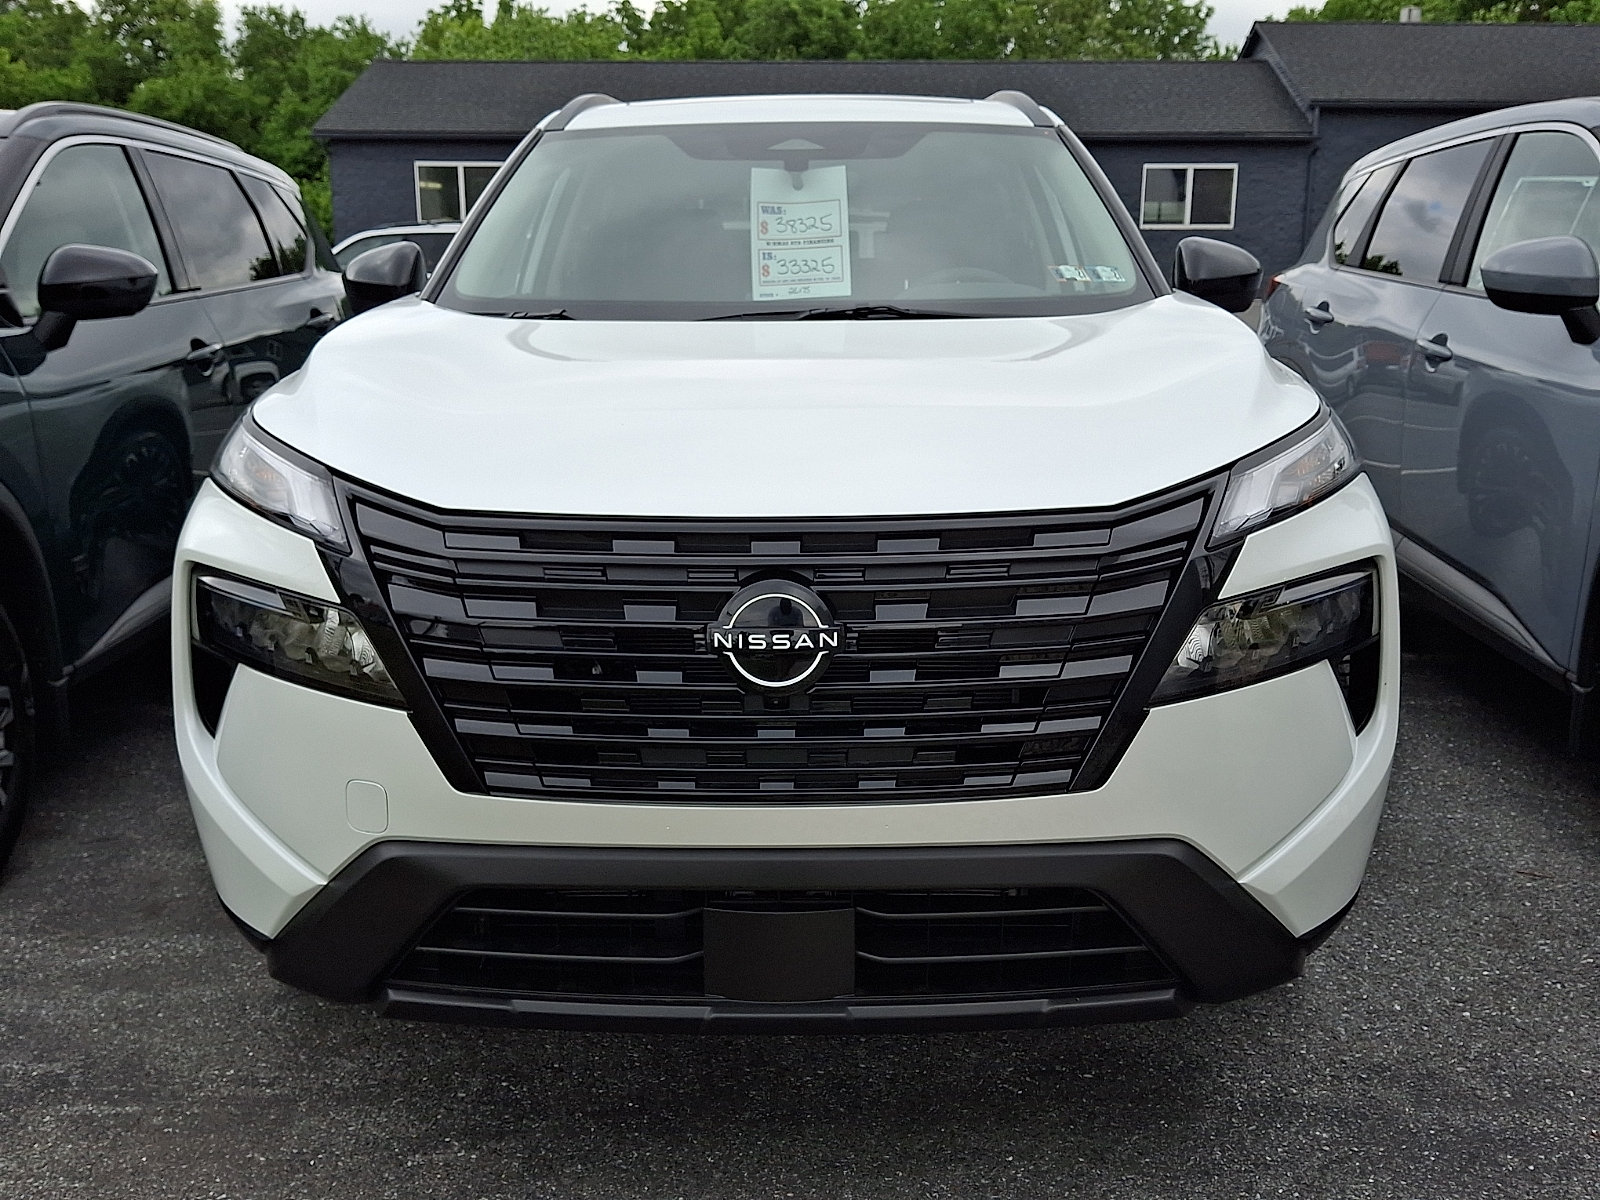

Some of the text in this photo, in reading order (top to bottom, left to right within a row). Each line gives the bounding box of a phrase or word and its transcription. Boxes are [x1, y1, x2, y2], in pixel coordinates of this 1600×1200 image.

[760, 205, 786, 215] WAS:
[775, 213, 833, 233] 38325
[762, 252, 777, 261] IS:
[776, 257, 835, 275] 33325
[713, 631, 838, 650] NISSAN
